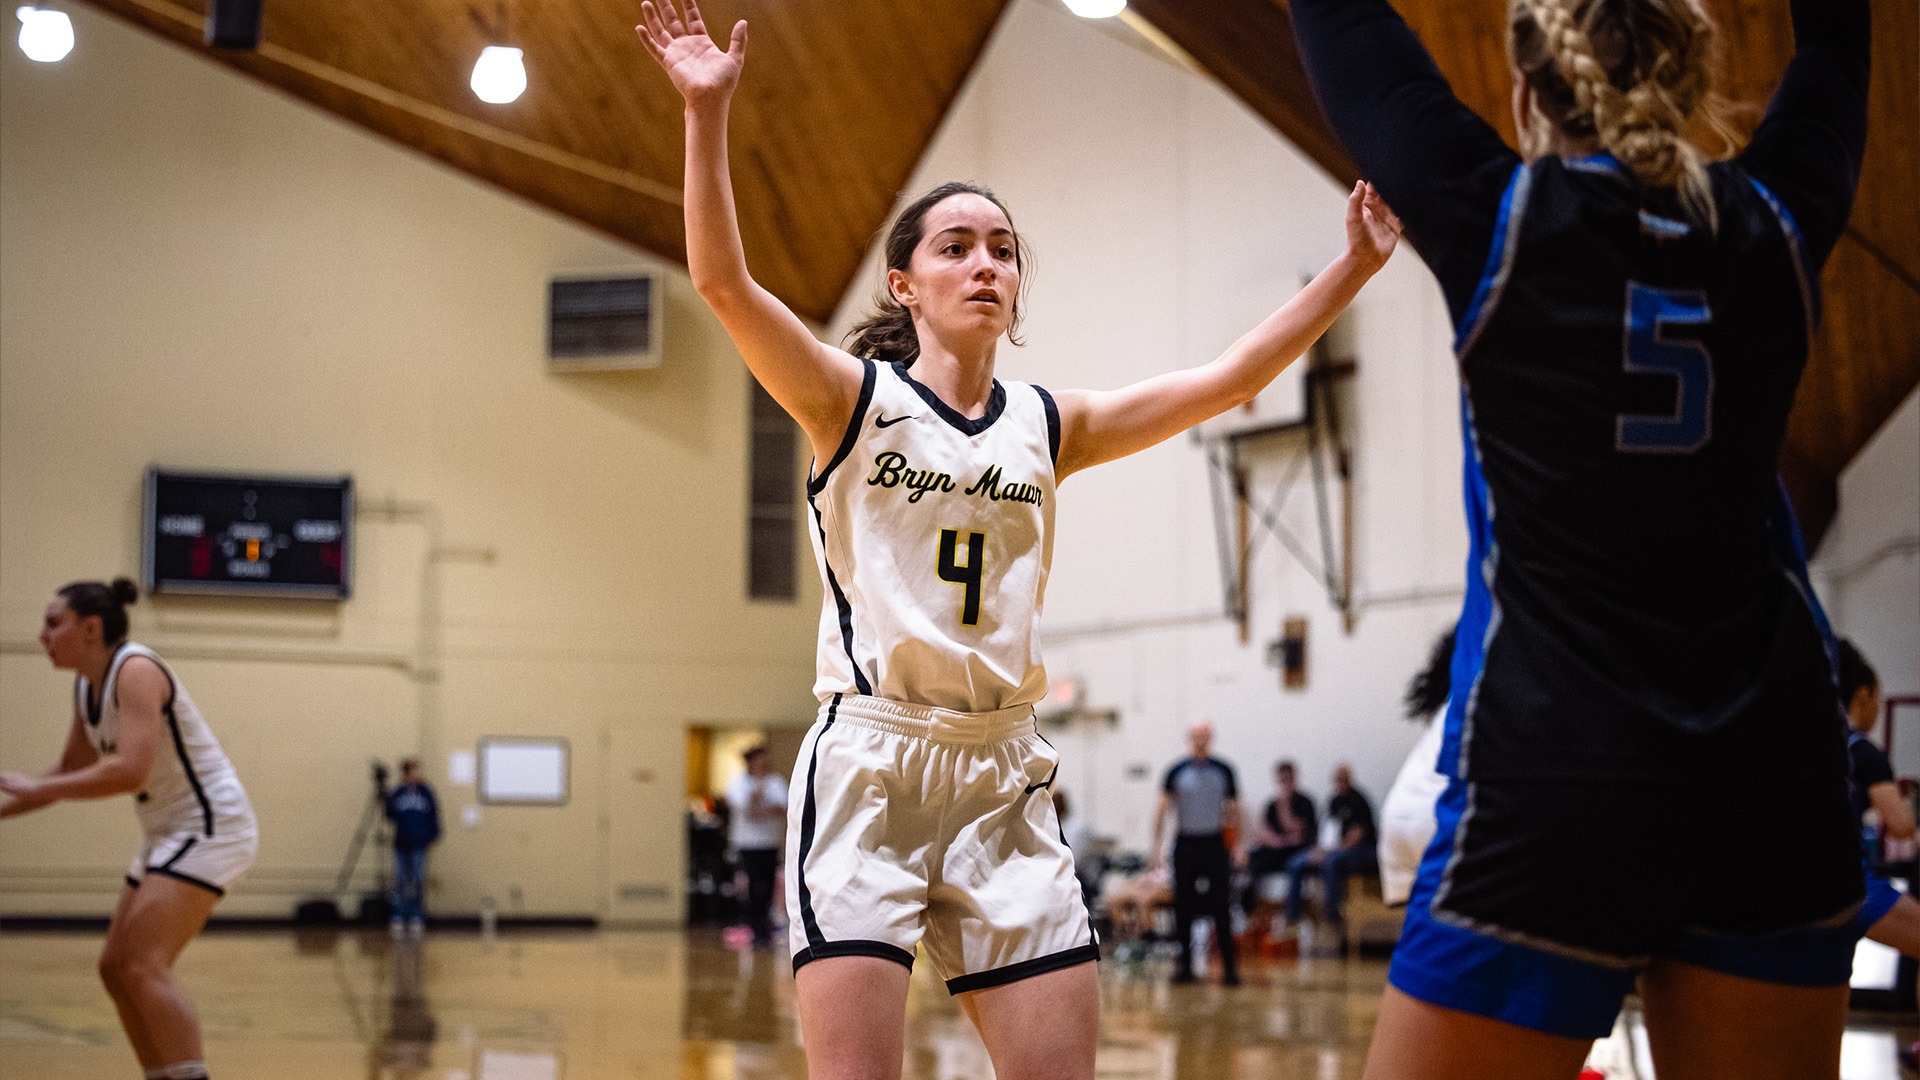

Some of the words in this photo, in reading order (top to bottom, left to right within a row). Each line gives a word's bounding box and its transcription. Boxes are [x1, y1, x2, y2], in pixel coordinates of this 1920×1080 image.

[1615, 279, 1715, 453] 5
[868, 451, 956, 503] Bryn
[965, 464, 1043, 507] Mawr
[937, 527, 986, 628] 4
